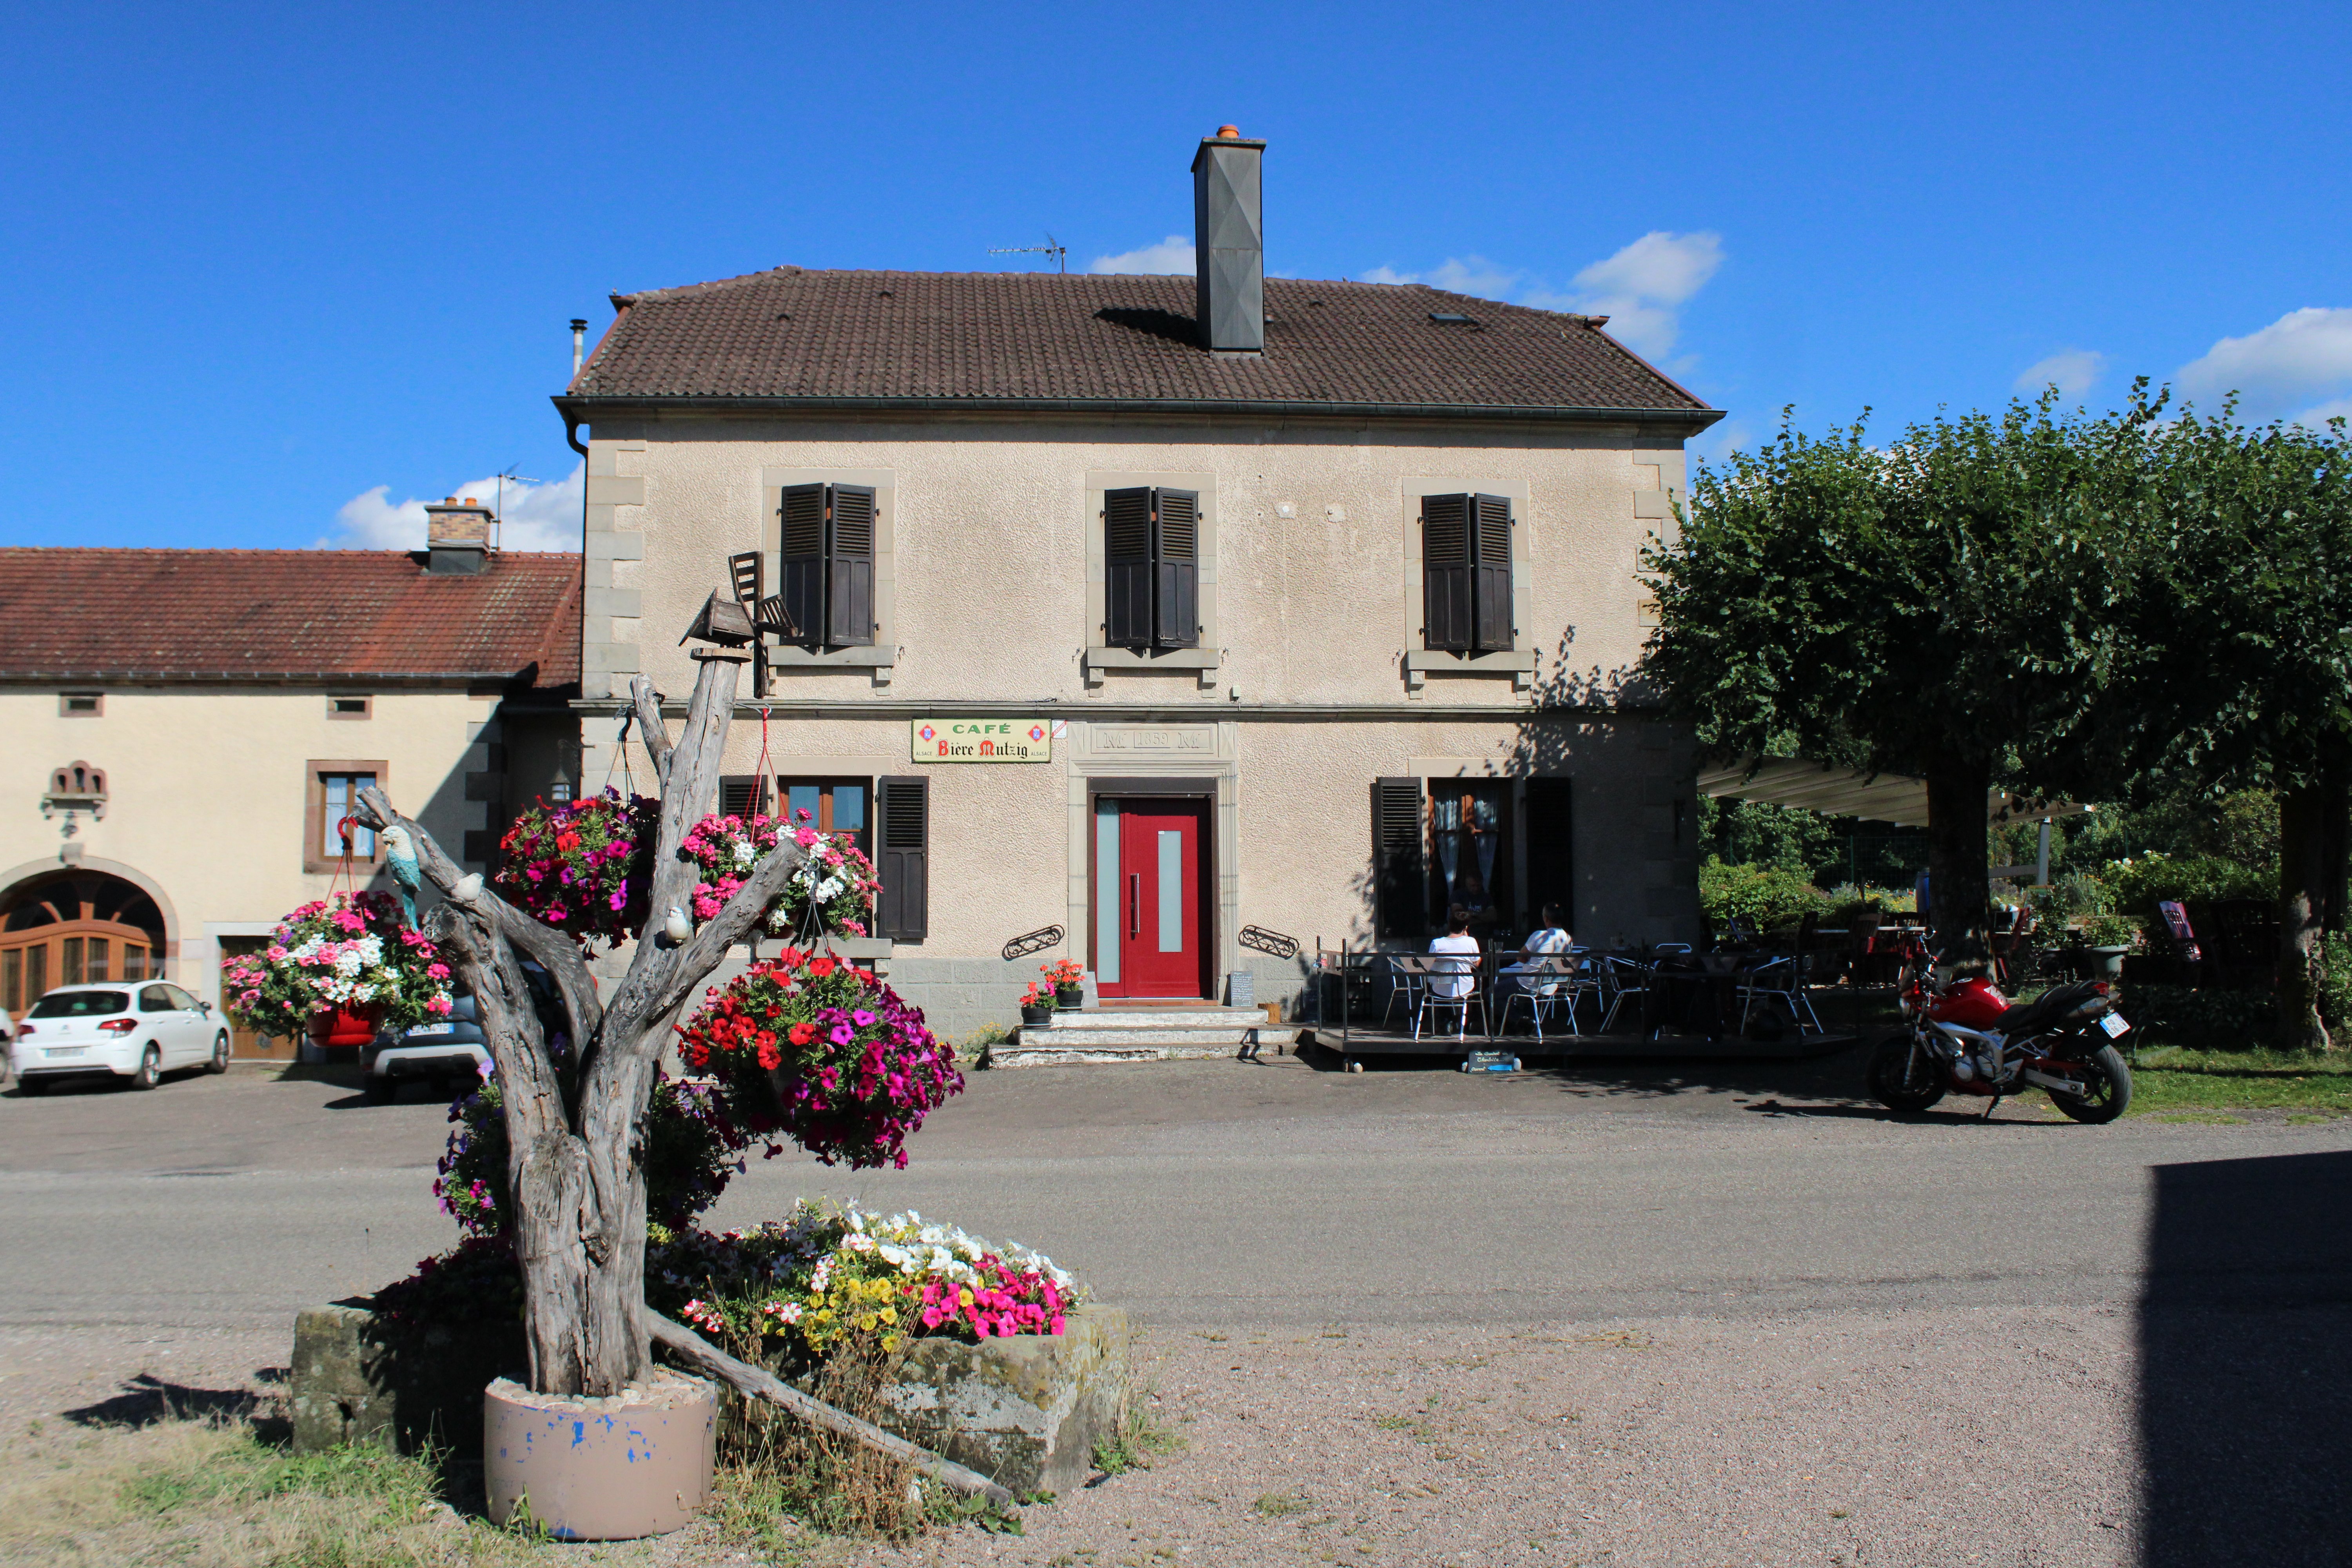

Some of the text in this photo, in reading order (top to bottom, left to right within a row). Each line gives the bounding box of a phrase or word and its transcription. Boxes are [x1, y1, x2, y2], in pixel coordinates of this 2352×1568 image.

[953, 723, 1011, 733] CAFÉ
[1054, 721, 1065, 735] LICENCE
[1138, 732, 1168, 745] 1859
[937, 740, 1028, 759] Bière Mutzig
